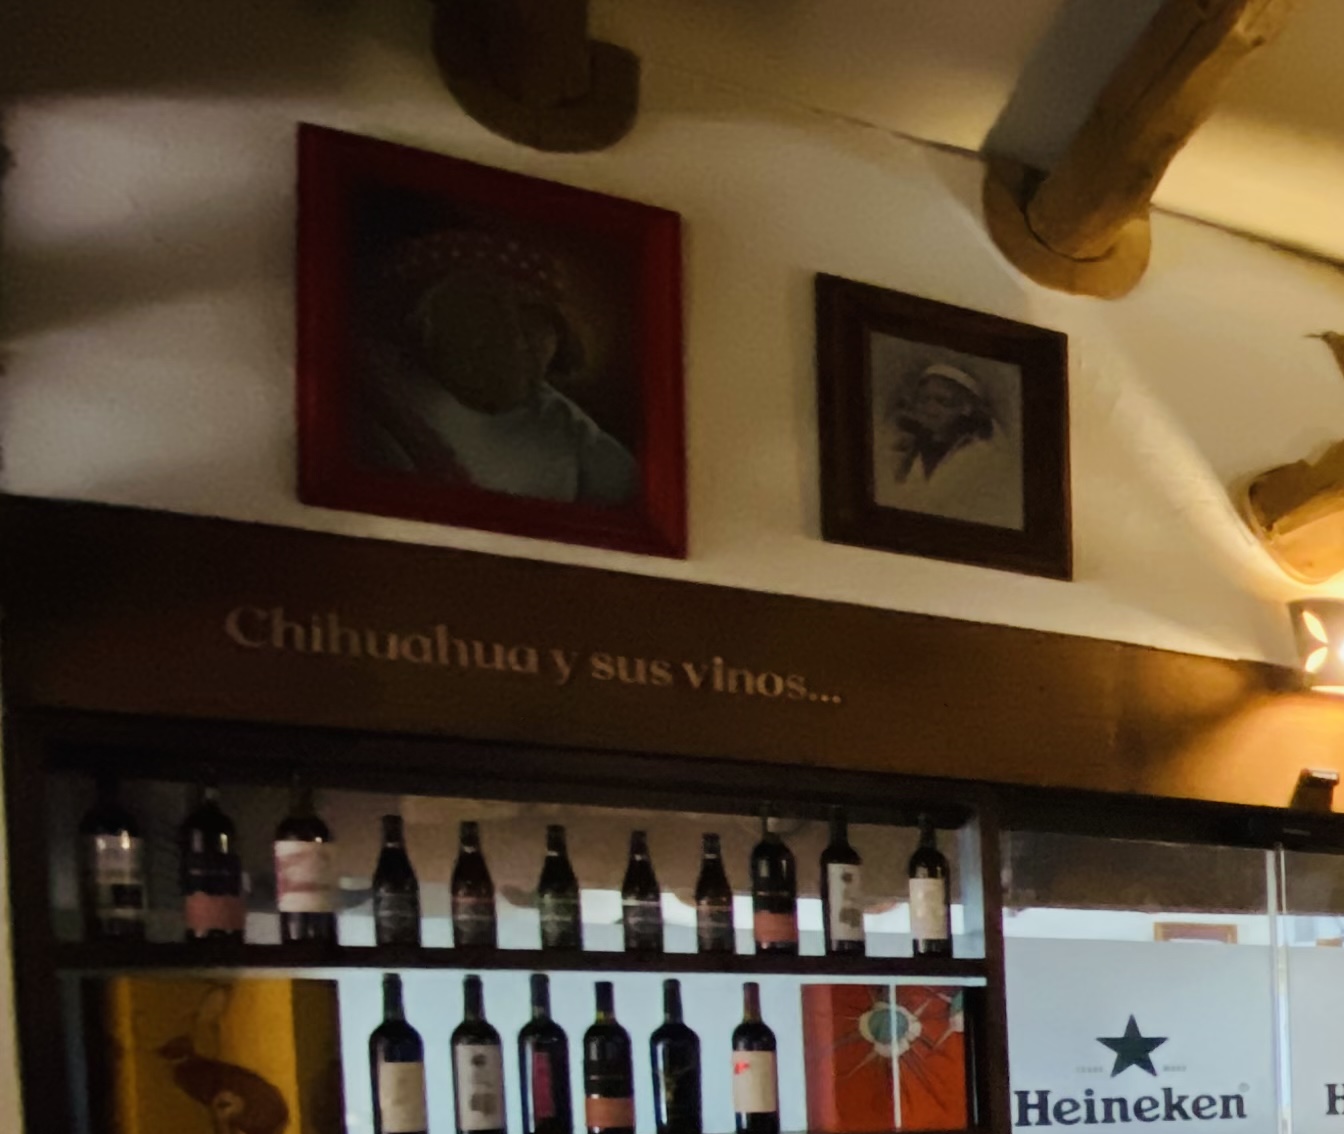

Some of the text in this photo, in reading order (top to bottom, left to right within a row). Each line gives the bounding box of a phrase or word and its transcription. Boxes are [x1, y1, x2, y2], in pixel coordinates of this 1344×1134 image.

[224, 605, 842, 703] Chihuahua y sus vinos...
[1013, 1086, 1248, 1127] Heineken
